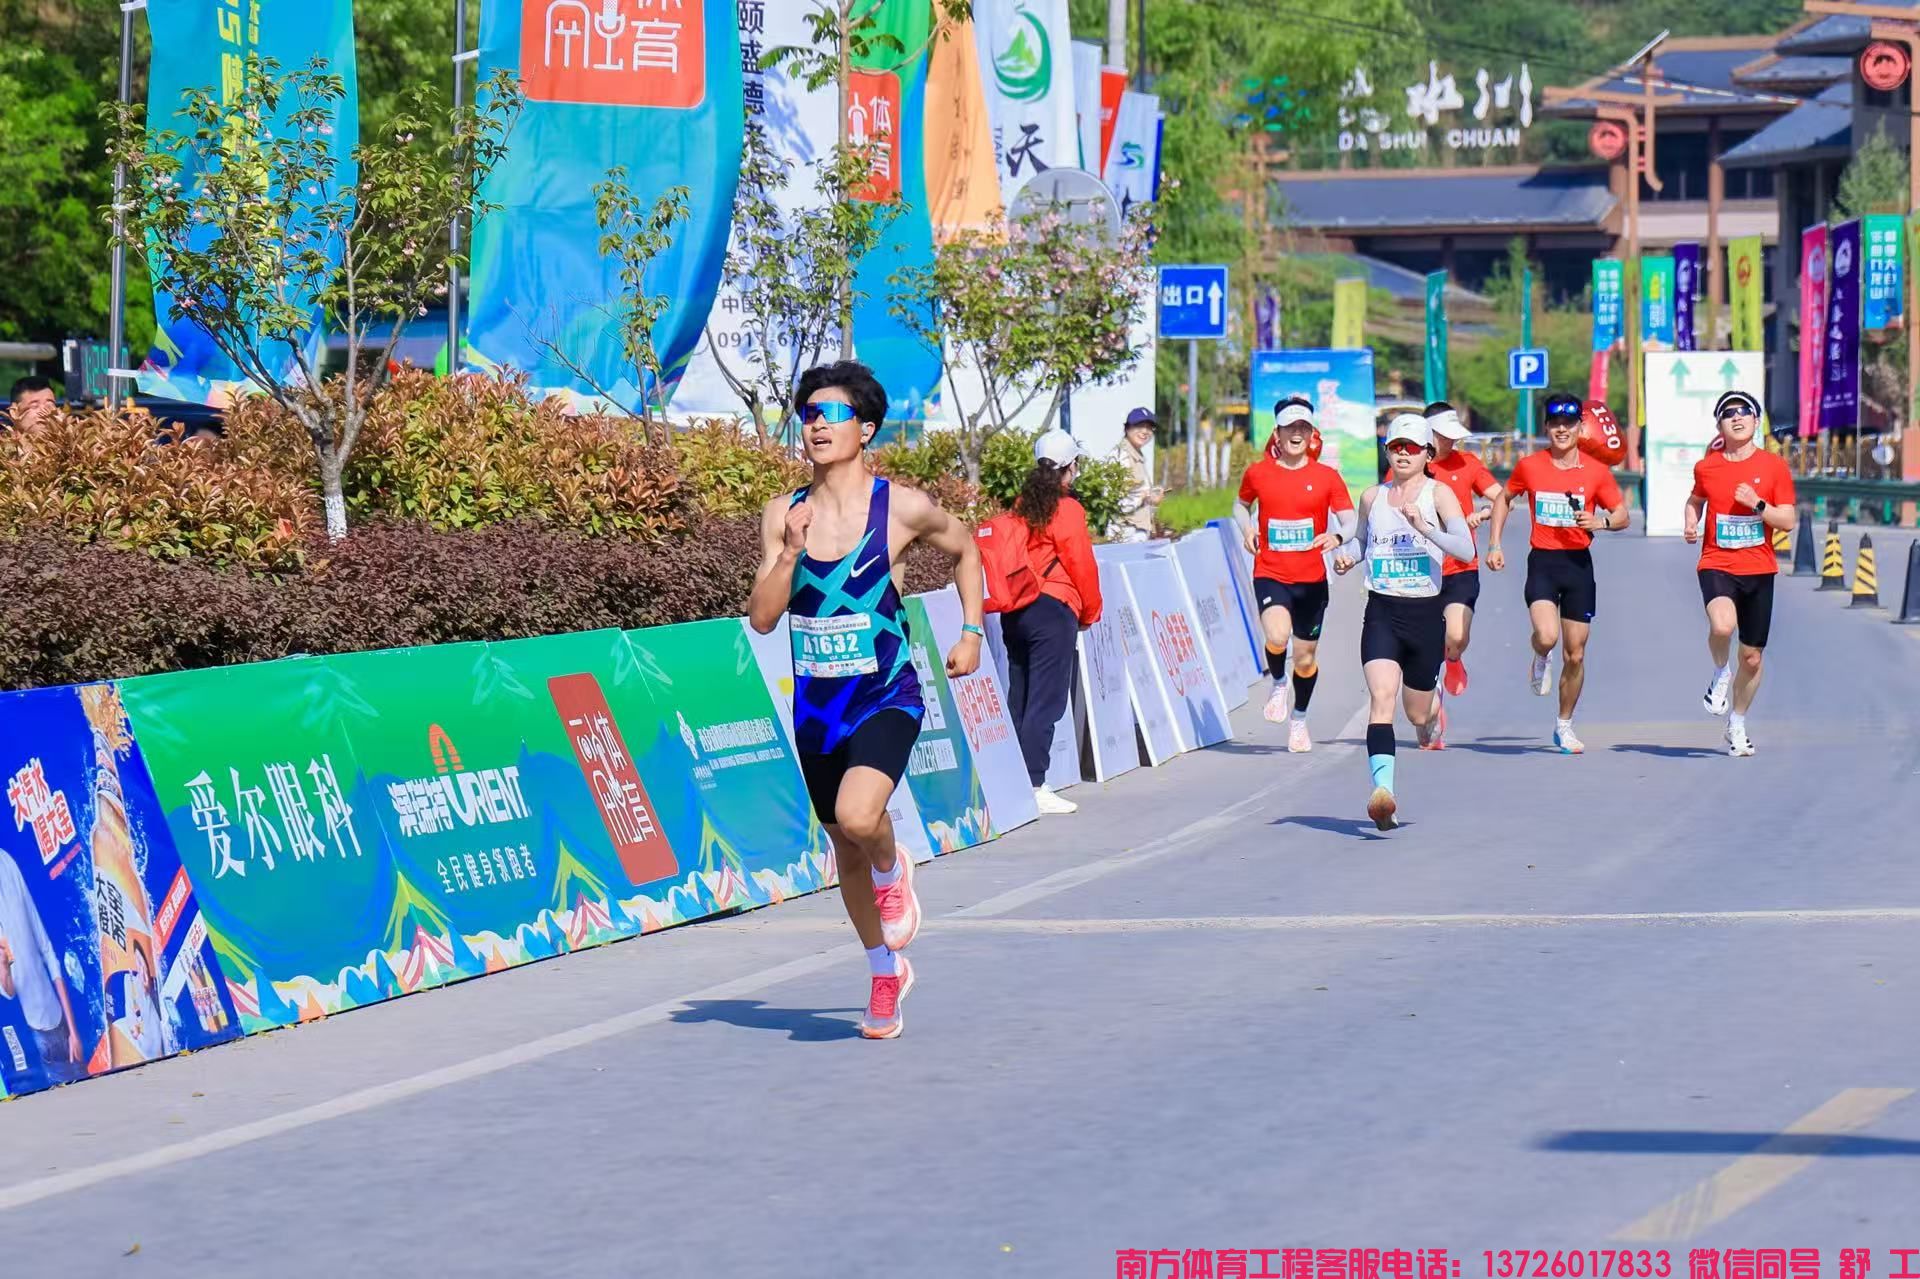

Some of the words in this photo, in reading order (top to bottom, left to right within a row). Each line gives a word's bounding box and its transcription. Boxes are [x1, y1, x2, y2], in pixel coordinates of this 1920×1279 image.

[1006, 123, 1050, 179] 天
[1447, 128, 1521, 149] CHUAN
[1162, 284, 1204, 307] 出口
[1518, 355, 1539, 382] P
[1592, 406, 1621, 449] 1:30
[1381, 559, 1419, 573] A1570
[803, 633, 859, 655] A1632
[184, 753, 362, 879] 爱尔眼科
[437, 843, 537, 893] 全民健身领跑者
